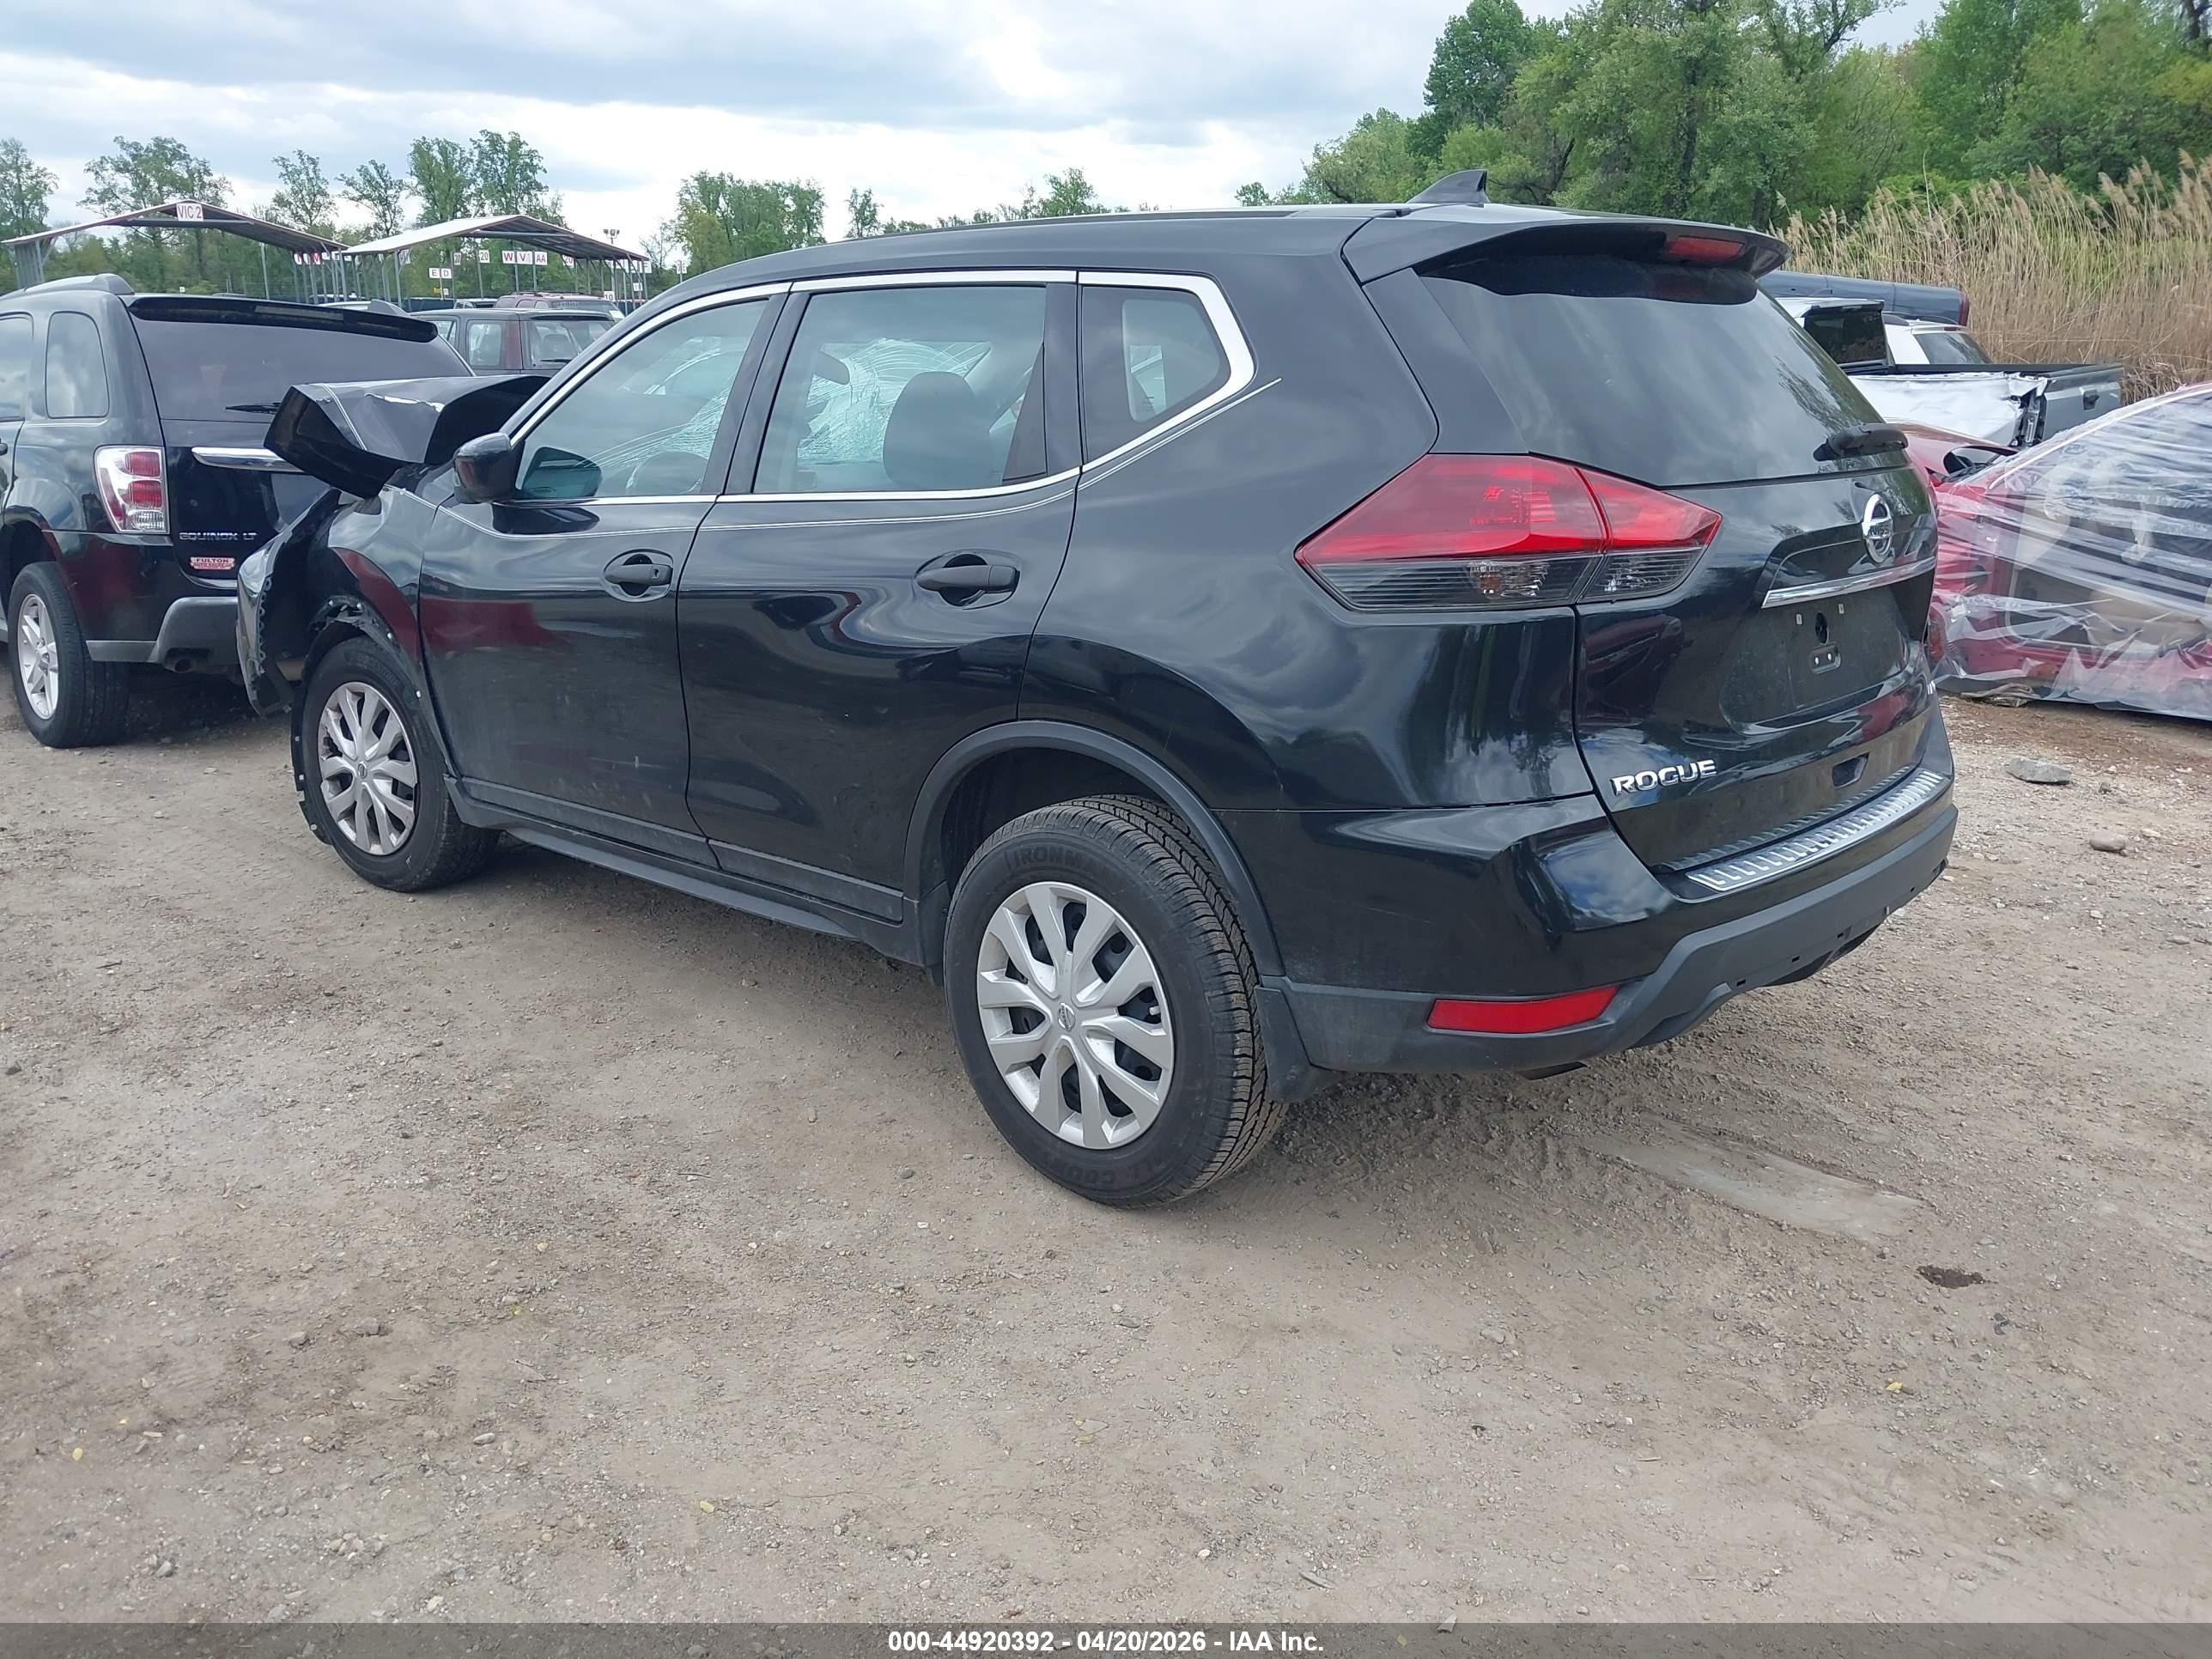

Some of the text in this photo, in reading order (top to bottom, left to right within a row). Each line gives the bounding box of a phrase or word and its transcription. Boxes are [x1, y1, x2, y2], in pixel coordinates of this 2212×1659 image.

[177, 206, 202, 219] VIC 2
[480, 252, 489, 260] 20
[503, 252, 514, 261] W
[243, 532, 257, 541] LT
[1610, 759, 1717, 795] ROGUE
